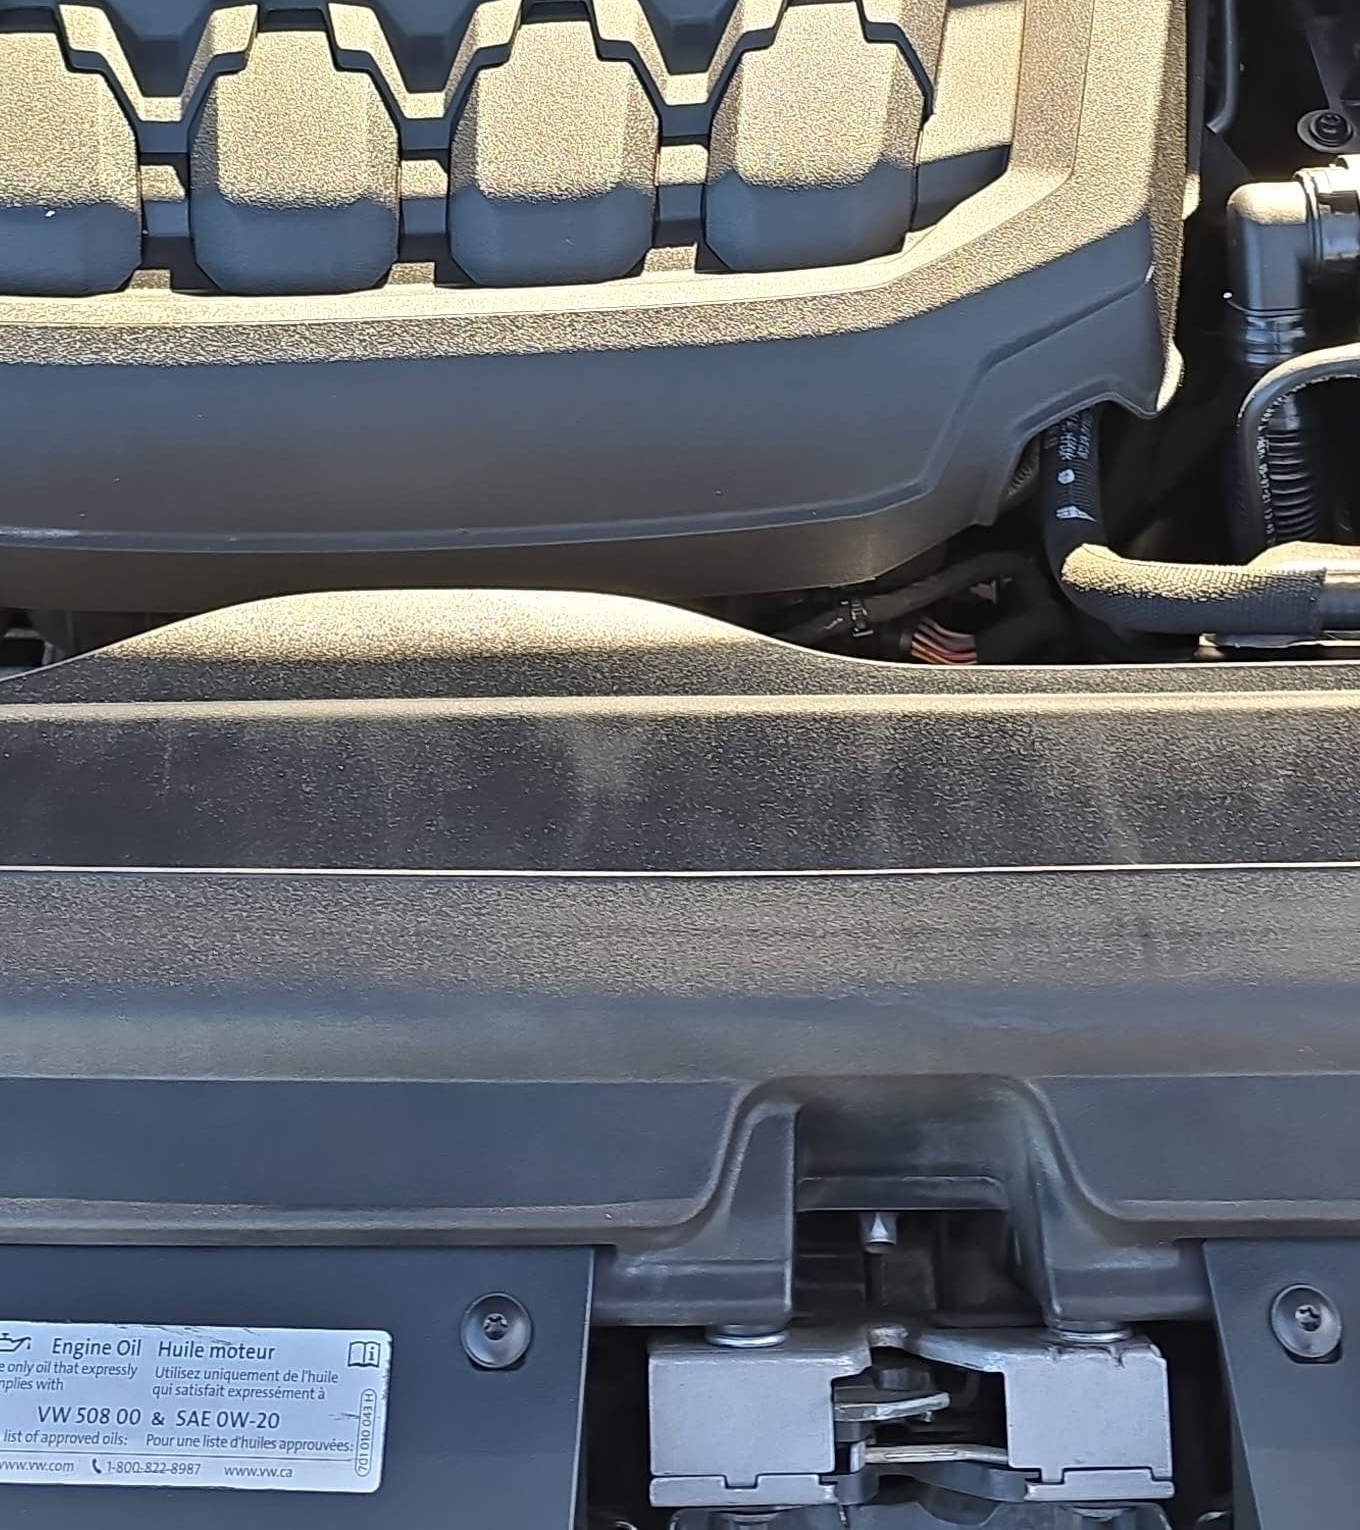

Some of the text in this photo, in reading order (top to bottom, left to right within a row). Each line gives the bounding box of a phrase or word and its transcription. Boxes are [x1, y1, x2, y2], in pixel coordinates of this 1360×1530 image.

[52, 1336, 276, 1360] Engine Oil Huile moteur
[6, 1361, 35, 1376] only
[36, 1361, 51, 1374] oil
[52, 1361, 80, 1375] that
[81, 1362, 138, 1379] expressly
[155, 1366, 339, 1384] Utilisez uniquement de l'huile
[35, 1378, 64, 1391] with
[152, 1384, 326, 1402] qui satisfait expressément à
[37, 1406, 281, 1429] VW 508 00 & SAE 0W-20
[2, 1429, 22, 1443] list
[24, 1429, 41, 1443] of
[41, 1431, 100, 1448] approved
[102, 1431, 128, 1446] oils:
[357, 1392, 375, 1472] 701 010 043 H
[146, 1434, 354, 1455] Pour une liste d'huiles approuvées:
[106, 1460, 201, 1476] 1-800-822-8987
[224, 1464, 293, 1478] www.vw.ca
